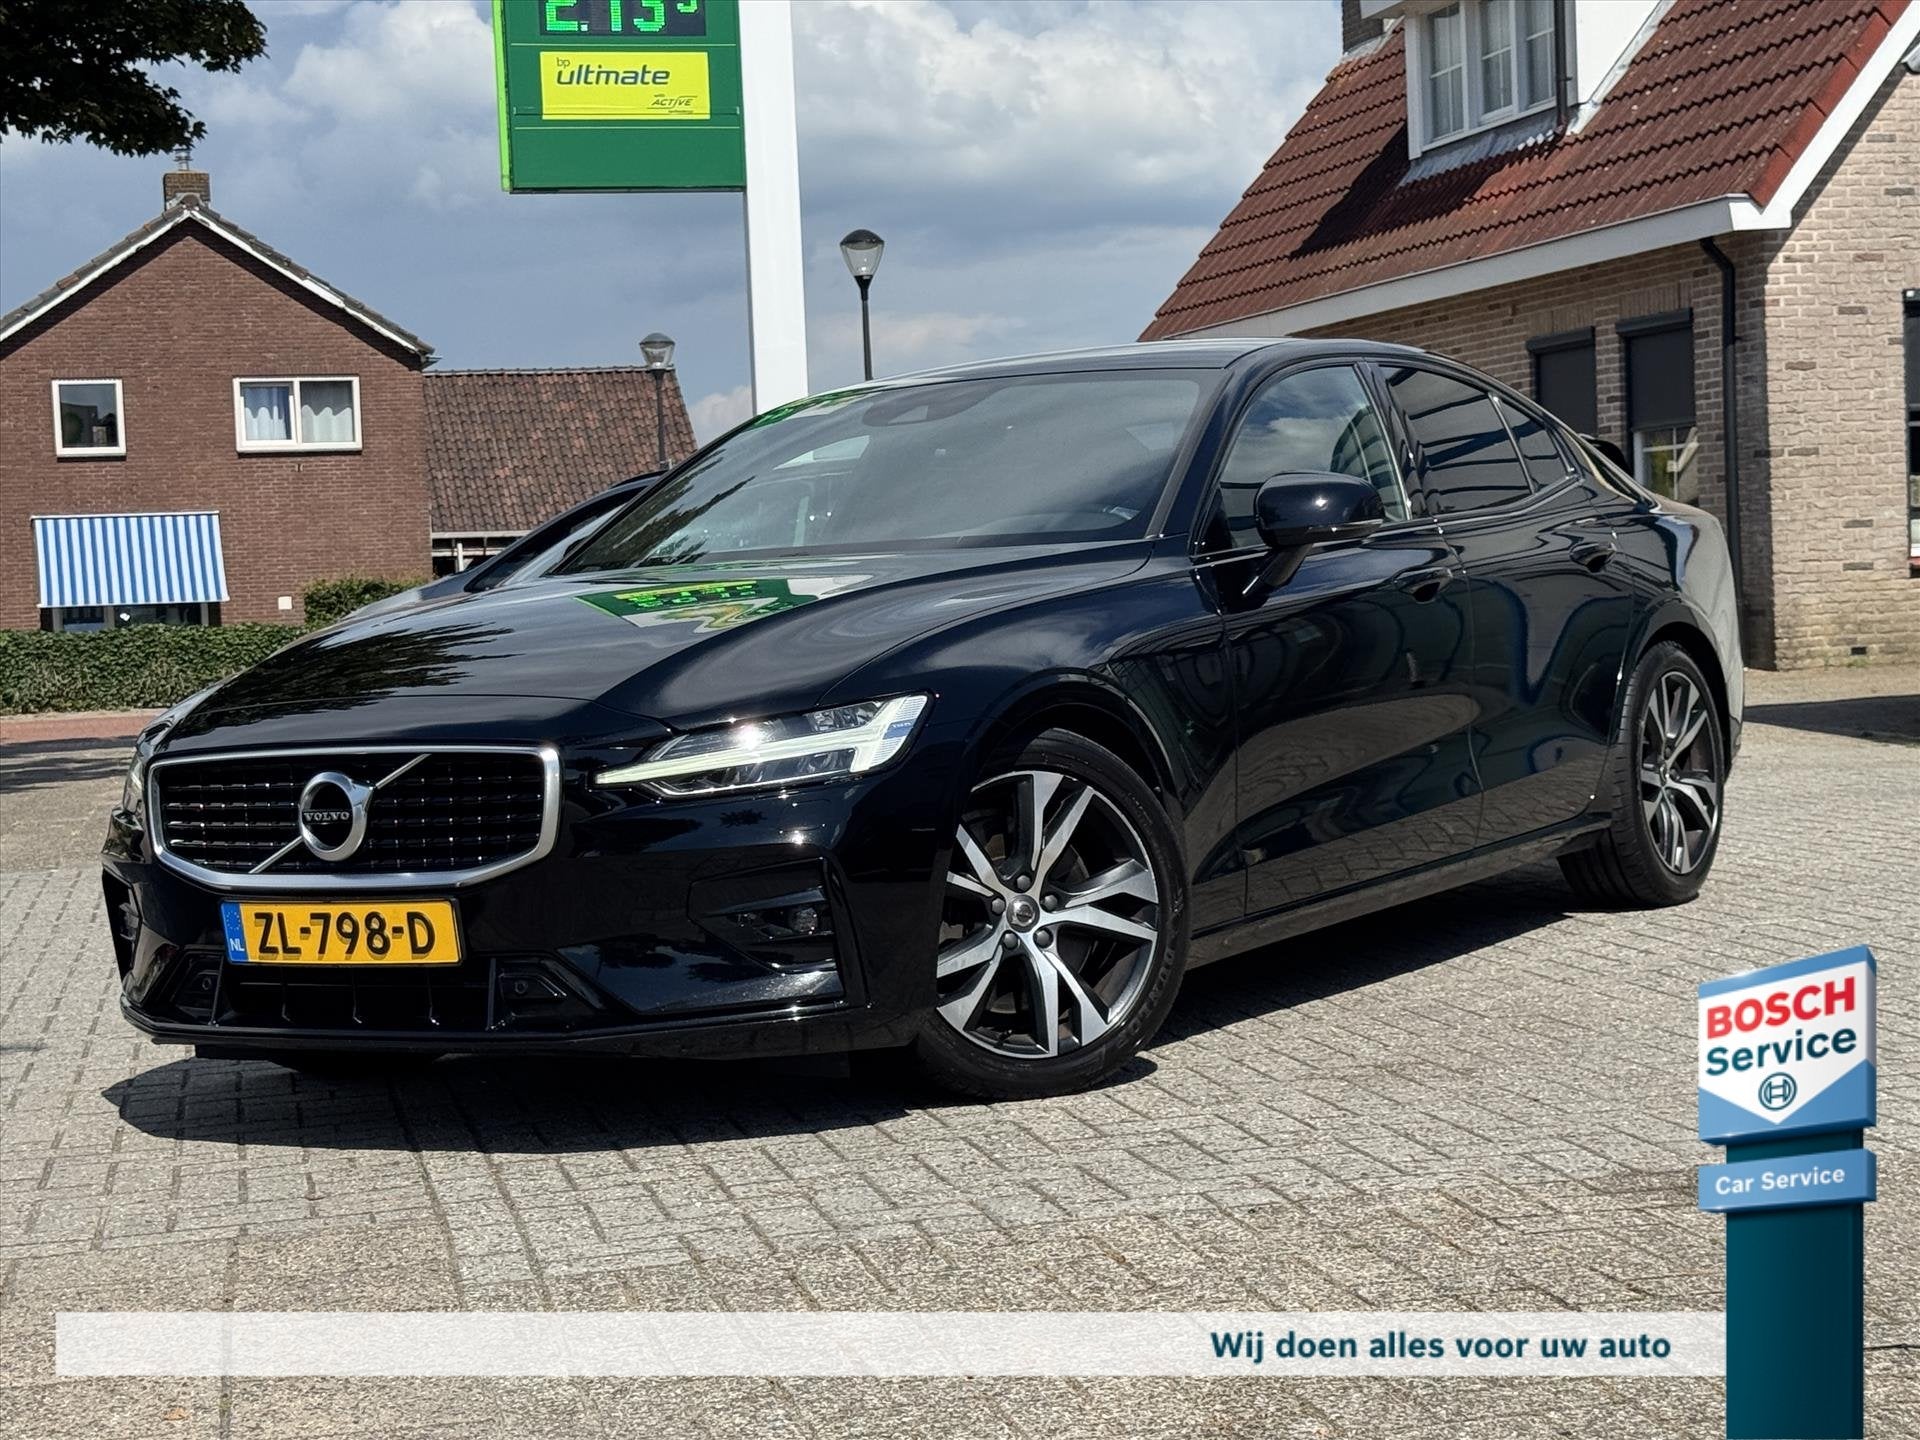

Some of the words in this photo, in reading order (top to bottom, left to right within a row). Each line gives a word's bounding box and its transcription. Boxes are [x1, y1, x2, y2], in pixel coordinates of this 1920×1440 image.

[556, 57, 571, 69] bp
[556, 64, 671, 86] ultimate
[650, 97, 695, 108] ACTIVE
[303, 811, 350, 821] VOLVO
[254, 911, 436, 955] ZL-798-D
[229, 938, 245, 952] NL
